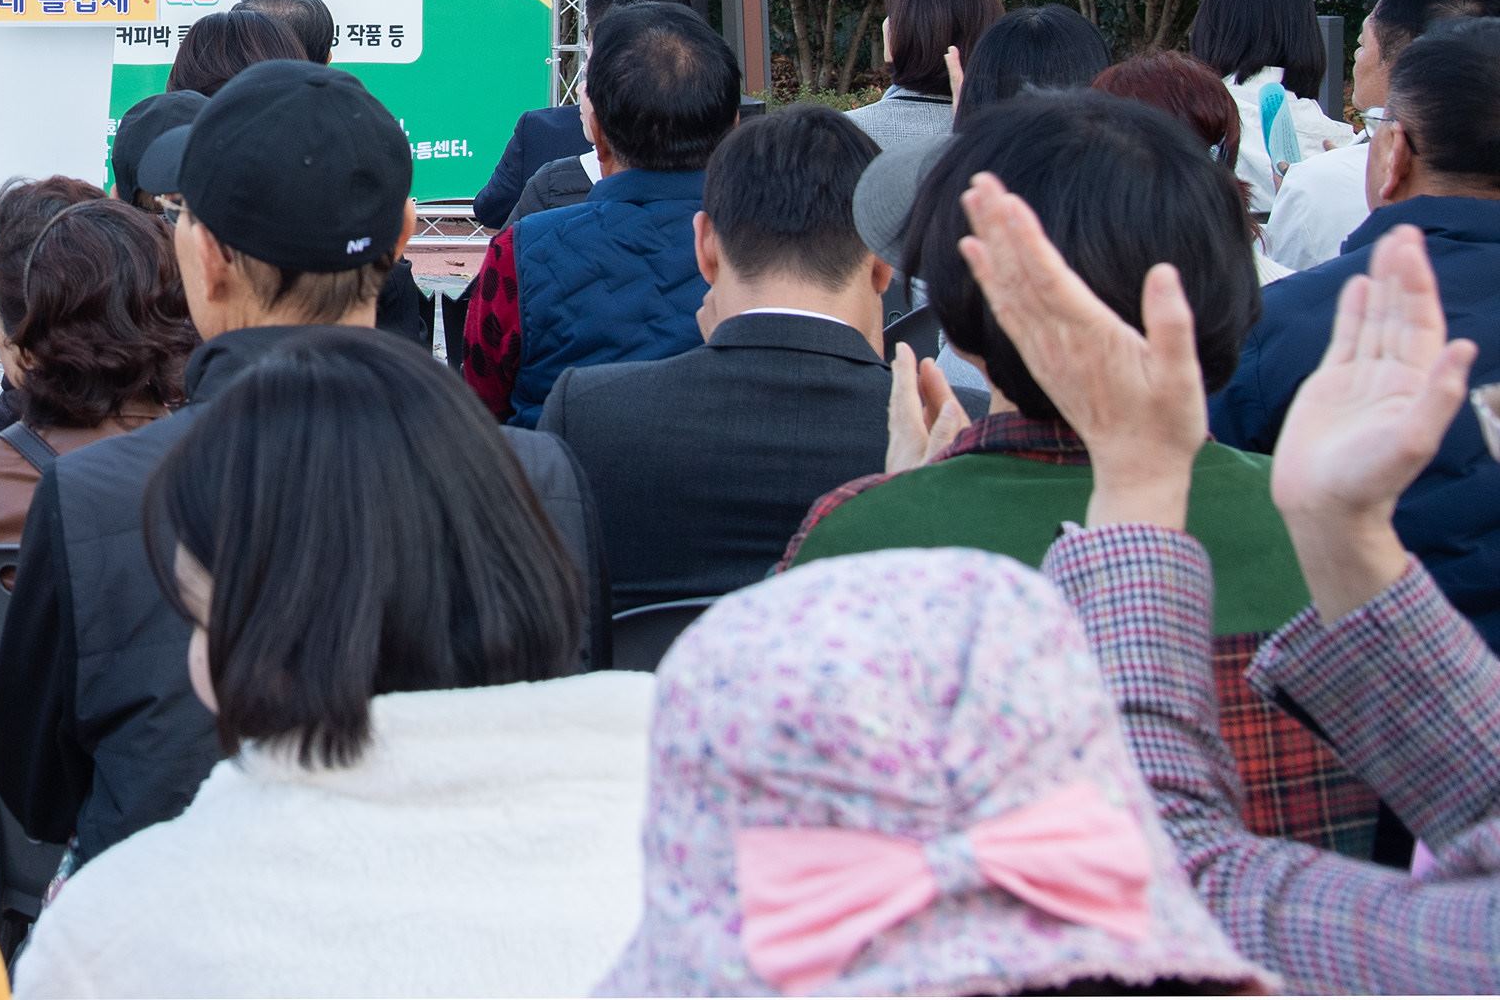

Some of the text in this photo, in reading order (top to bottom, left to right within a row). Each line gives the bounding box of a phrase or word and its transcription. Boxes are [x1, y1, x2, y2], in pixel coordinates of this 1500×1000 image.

[116, 25, 172, 48] 커피박
[346, 24, 382, 47] 작품
[388, 24, 405, 48] 등
